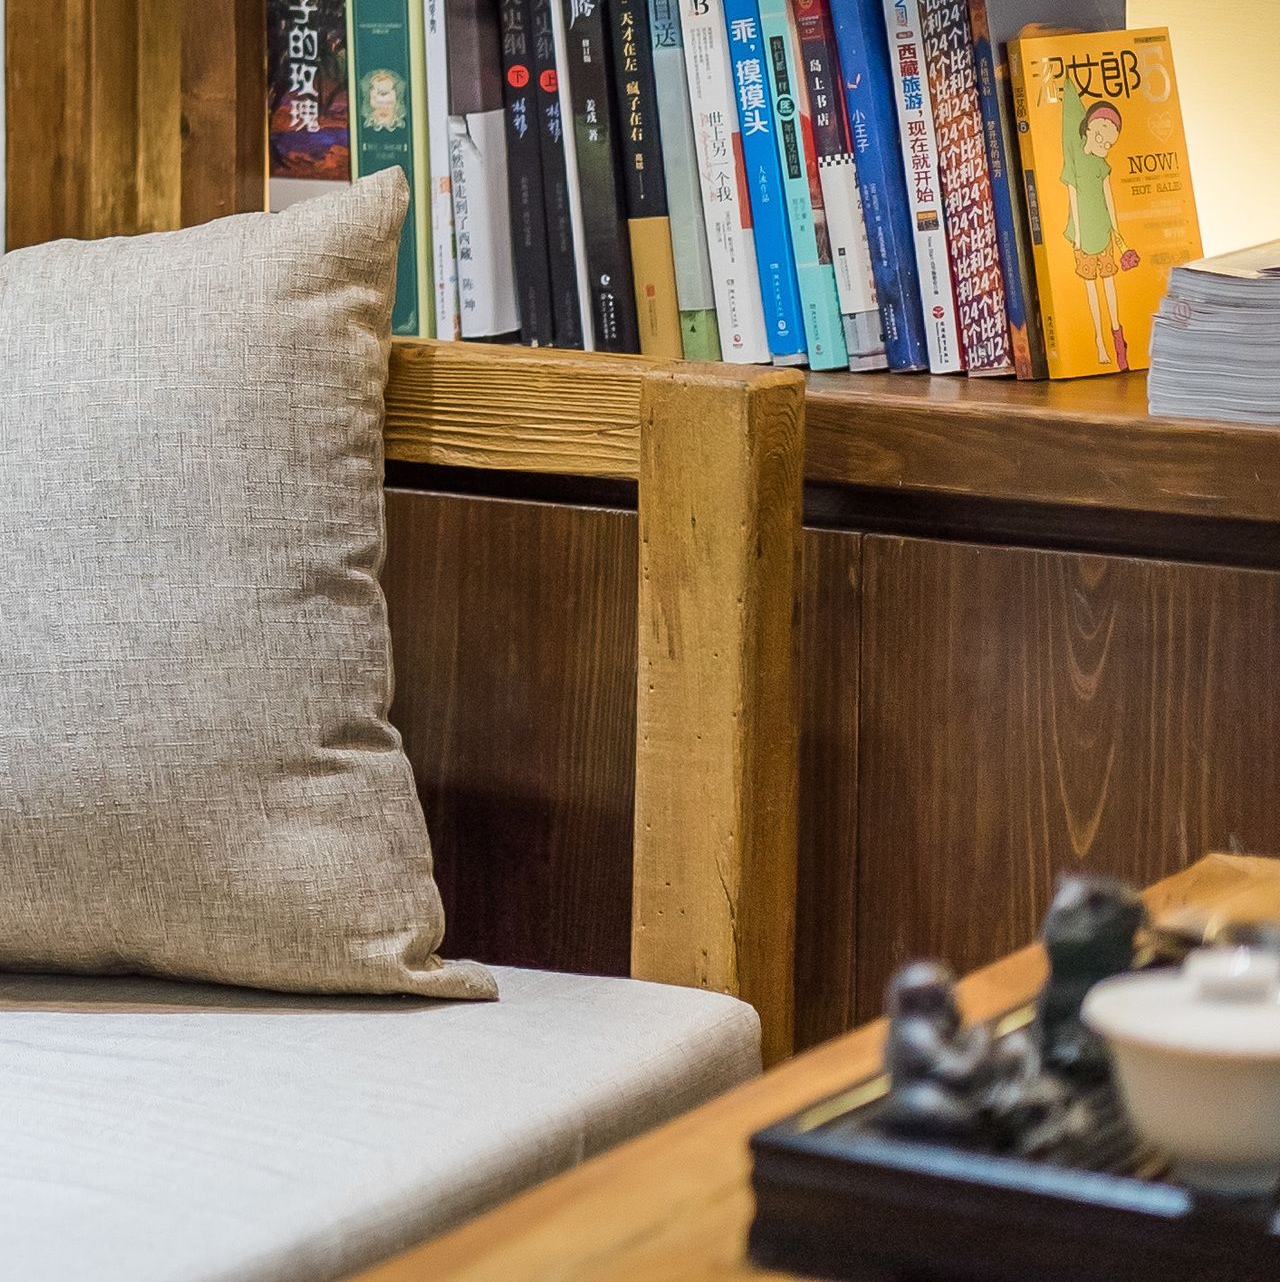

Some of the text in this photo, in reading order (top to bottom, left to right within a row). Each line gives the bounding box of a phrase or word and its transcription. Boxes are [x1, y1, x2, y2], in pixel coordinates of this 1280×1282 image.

[620, 12, 638, 71] 天才在左
[512, 68, 525, 84] 下
[731, 17, 769, 136] 乖，摸摸头
[810, 59, 829, 127] 岛上书店
[1141, 46, 1171, 103] 5
[626, 81, 643, 142] 疯子在右
[852, 109, 870, 152] 小王子
[709, 111, 733, 203] 世上另一个我
[1128, 151, 1180, 175] NOW!
[1131, 184, 1152, 196] HOT
